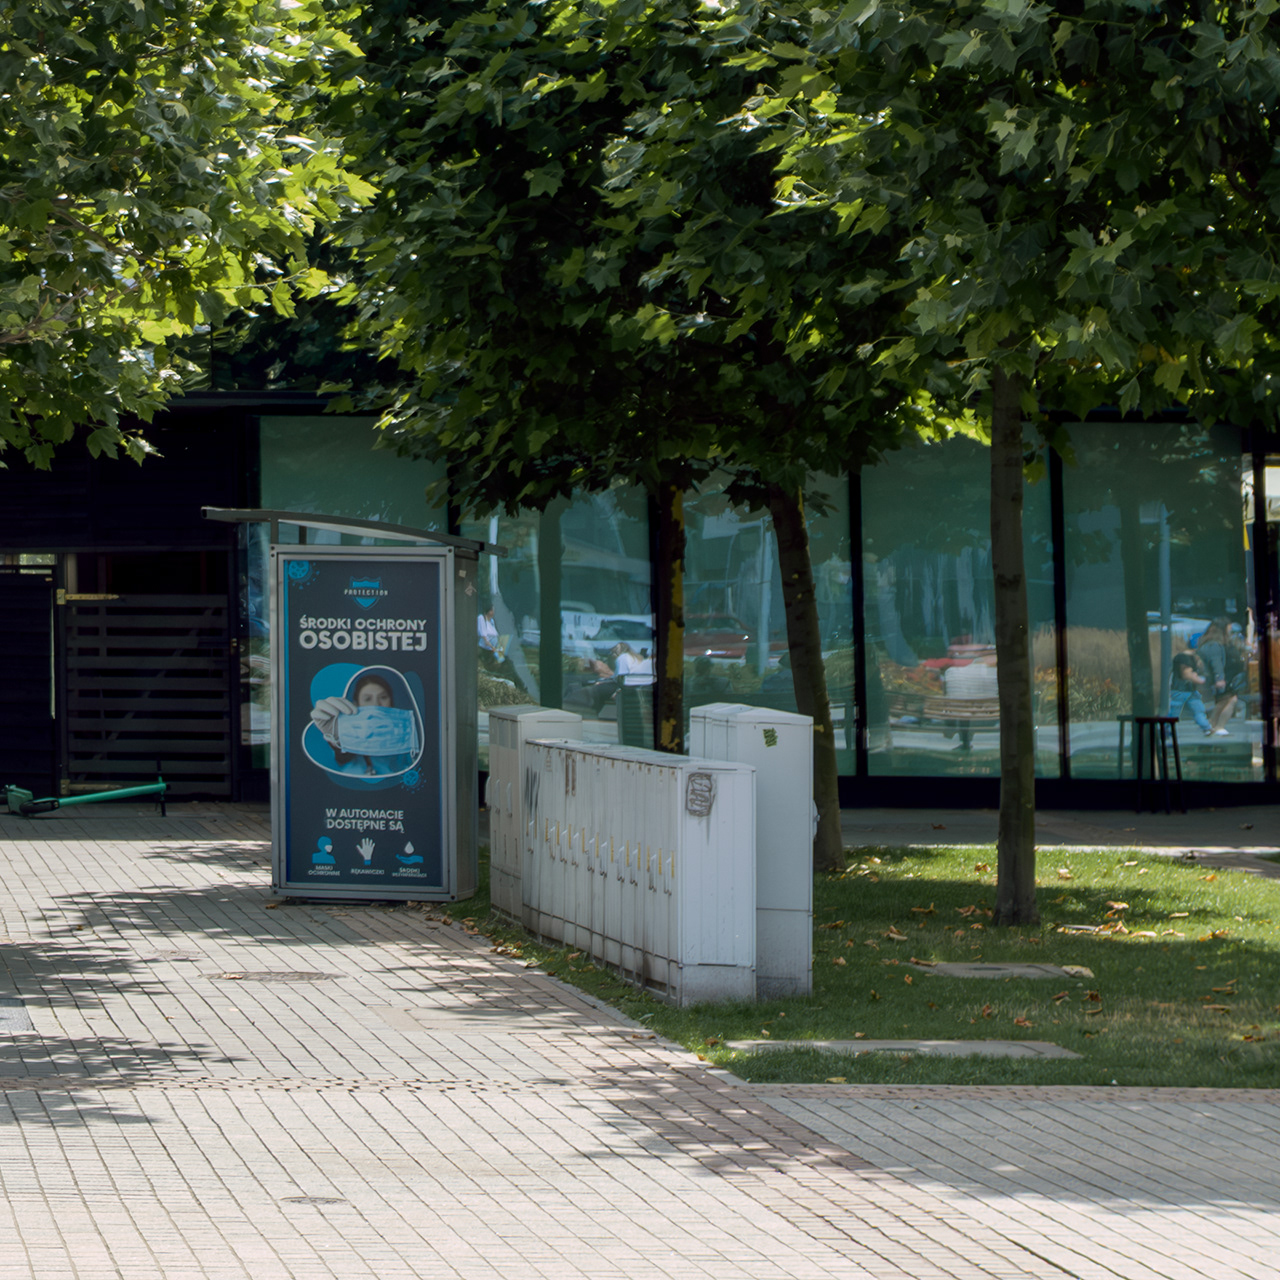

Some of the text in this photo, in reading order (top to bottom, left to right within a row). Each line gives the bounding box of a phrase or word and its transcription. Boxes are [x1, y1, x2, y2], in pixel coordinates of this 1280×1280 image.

[299, 614, 427, 631] ŚRODKI OCHRONY
[299, 630, 428, 652] OSOBISTEJ
[326, 808, 404, 819] W AUTOMACIE
[326, 819, 405, 833] DOSTĘPNE SĄ
